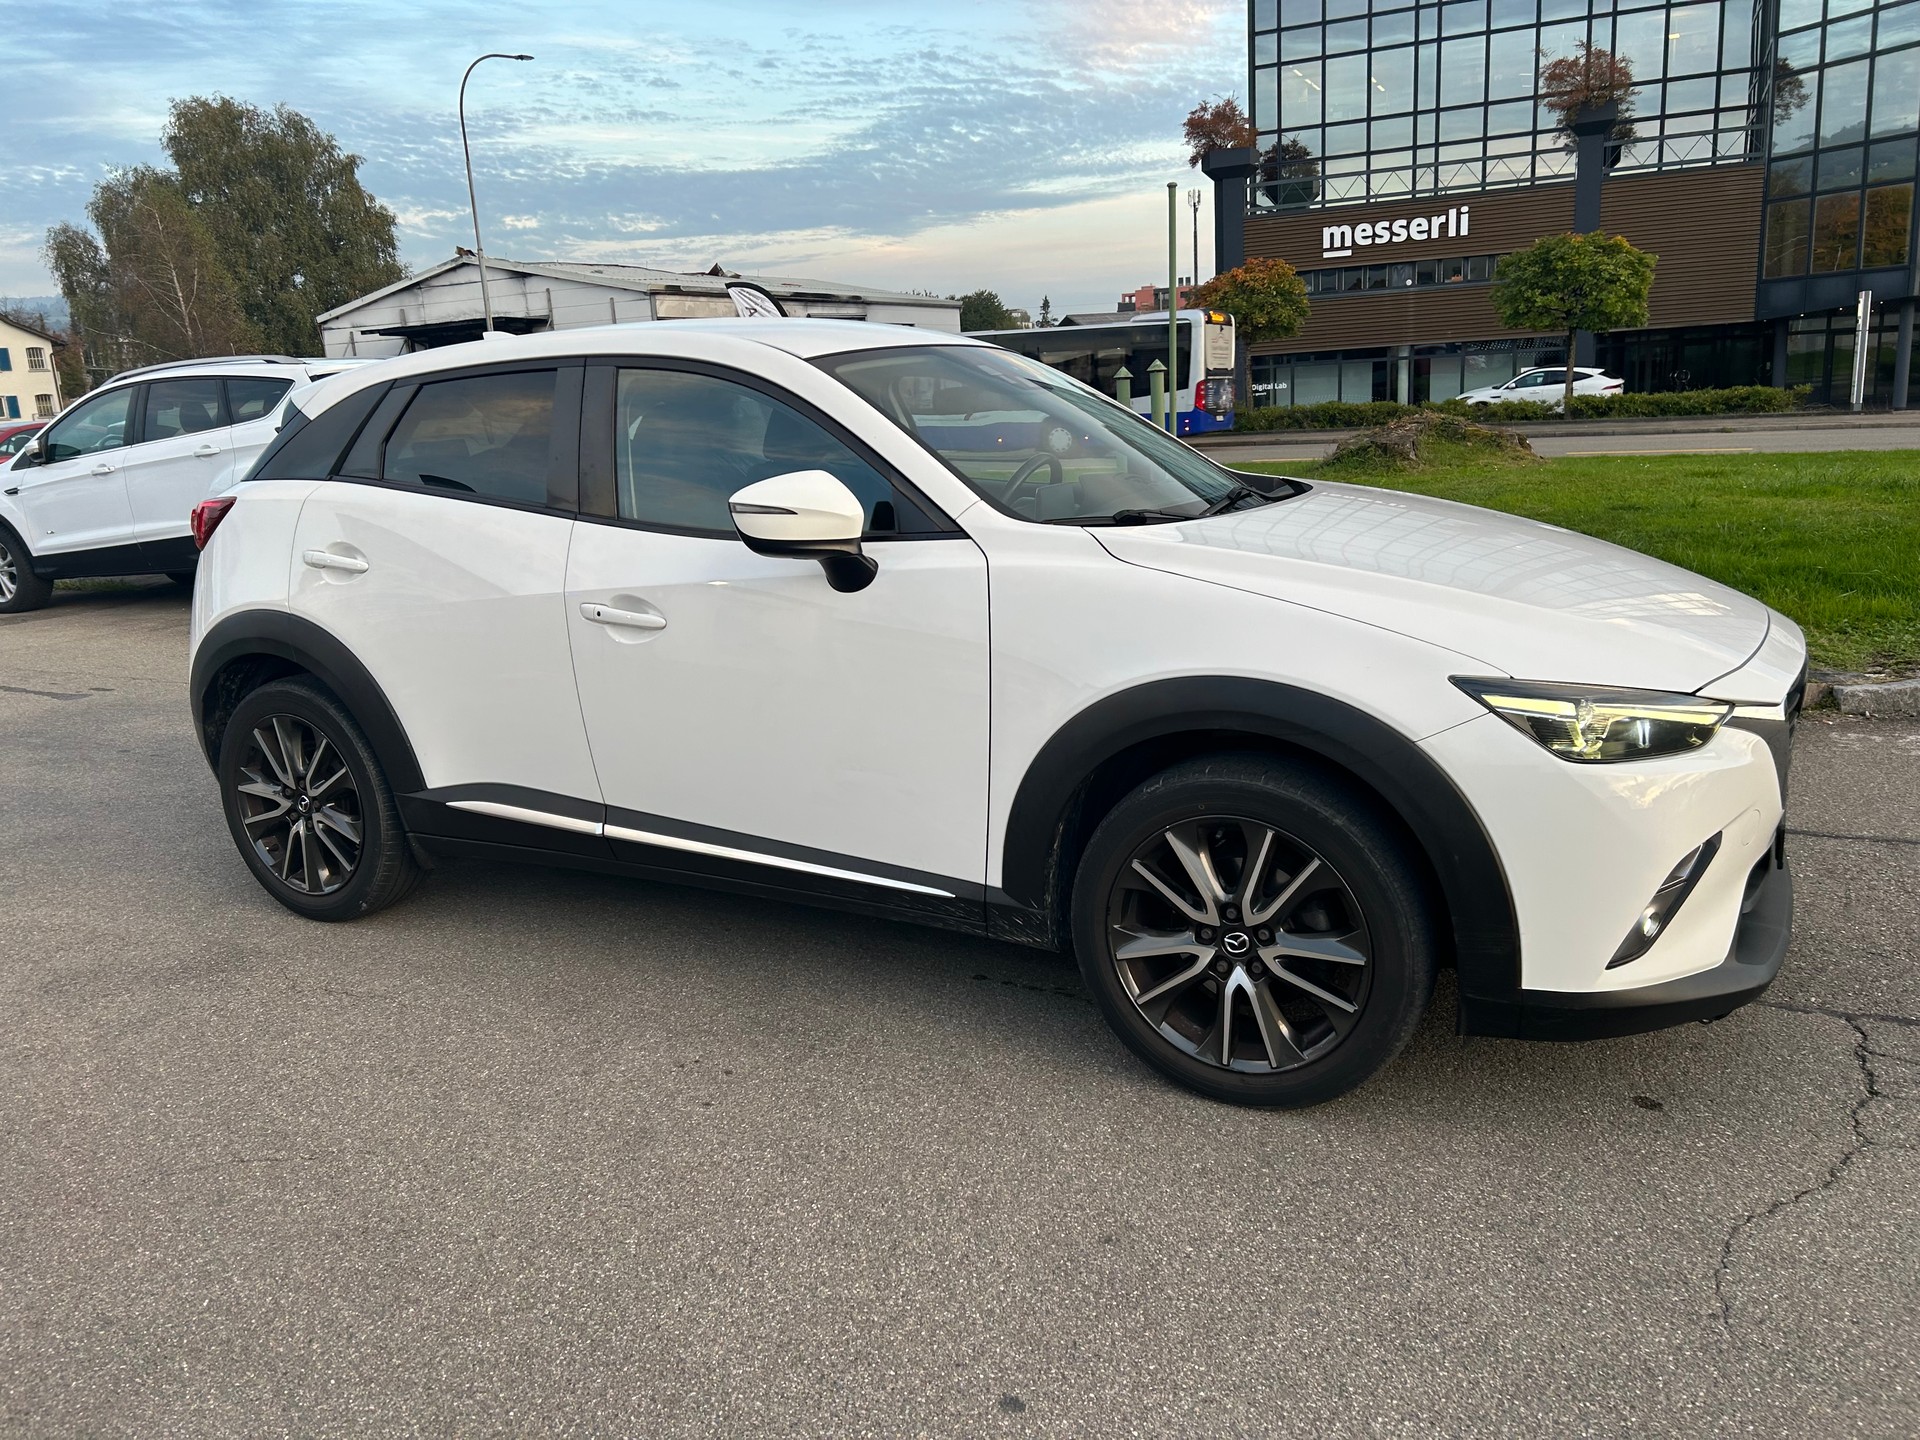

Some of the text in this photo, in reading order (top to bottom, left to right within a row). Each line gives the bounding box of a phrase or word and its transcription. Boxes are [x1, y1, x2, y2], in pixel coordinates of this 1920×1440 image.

[1322, 206, 1470, 258] messerli
[1251, 382, 1288, 392] Digital Lab
